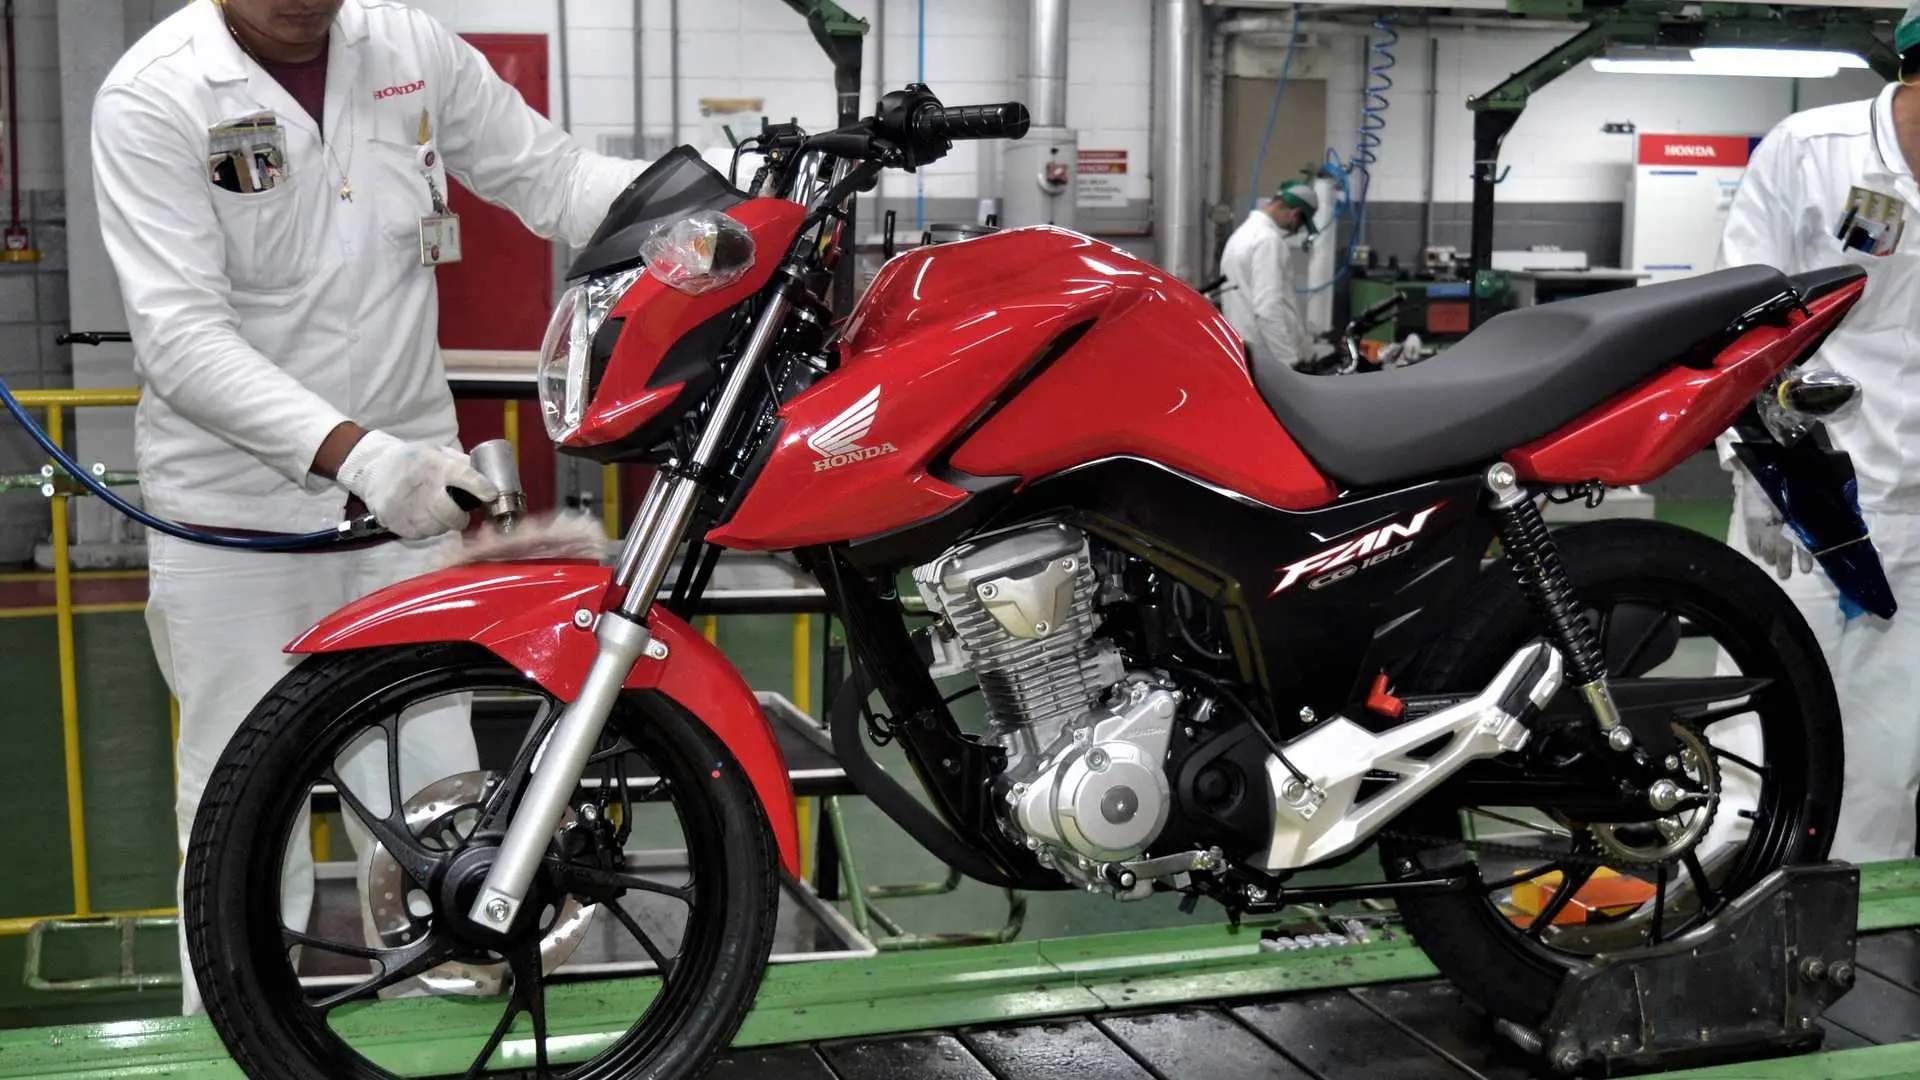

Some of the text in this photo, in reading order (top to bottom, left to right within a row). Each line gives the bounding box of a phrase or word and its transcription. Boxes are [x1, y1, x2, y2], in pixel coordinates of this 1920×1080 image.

[373, 80, 425, 101] HONDA
[1664, 144, 1717, 157] HONDA
[813, 442, 899, 472] HONDA
[1270, 503, 1441, 595] FAN
[1308, 540, 1414, 590] CG 160
